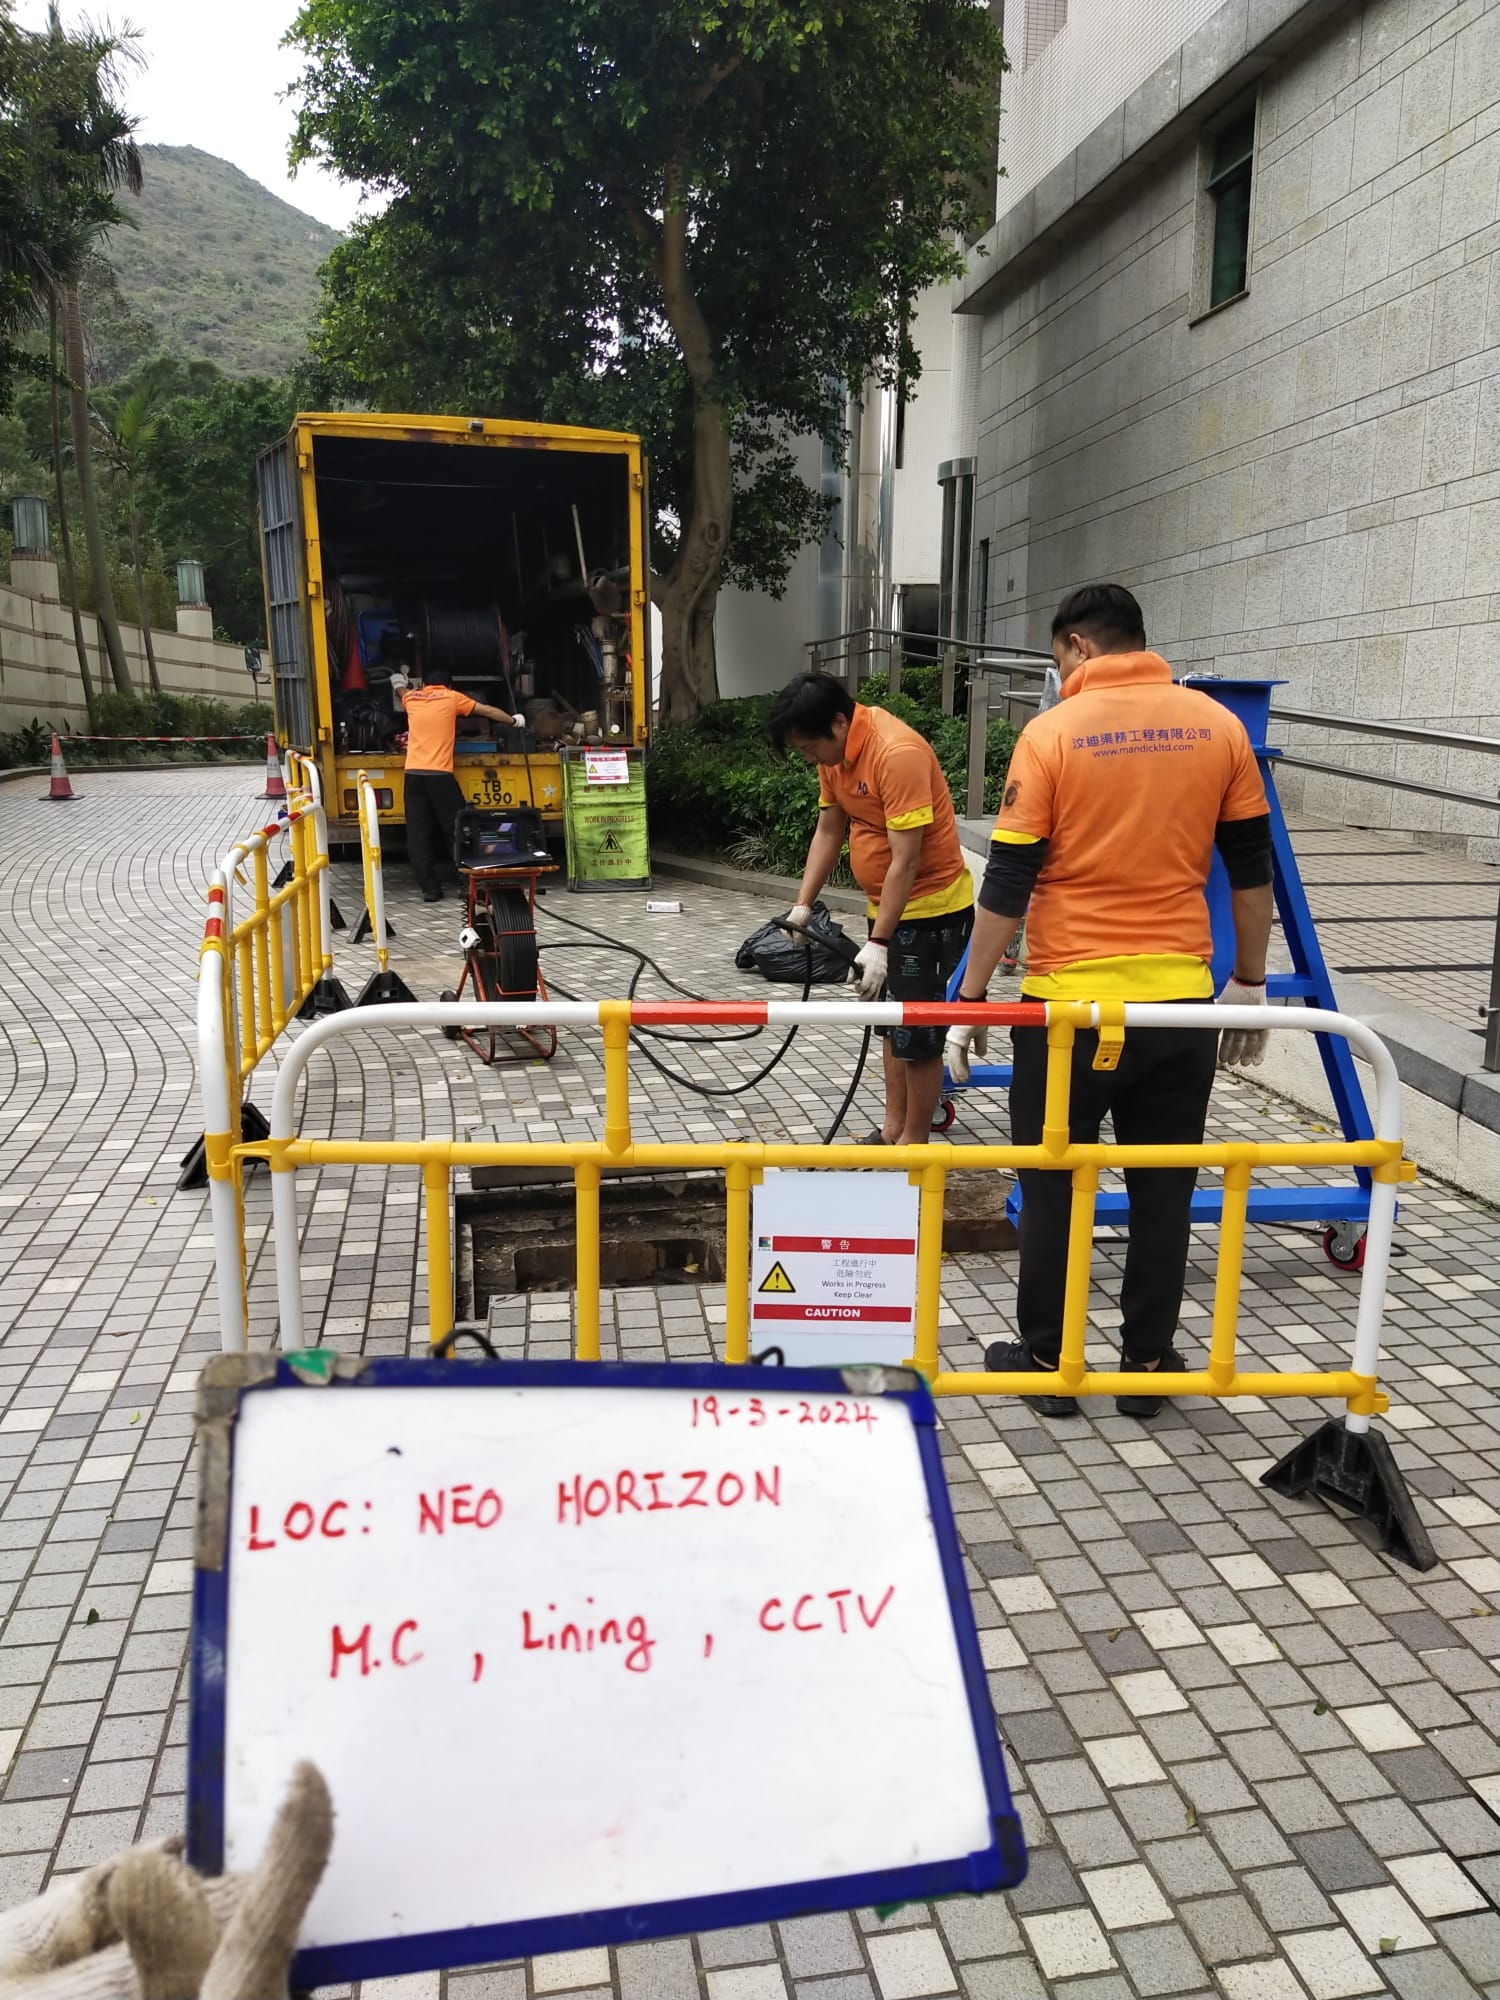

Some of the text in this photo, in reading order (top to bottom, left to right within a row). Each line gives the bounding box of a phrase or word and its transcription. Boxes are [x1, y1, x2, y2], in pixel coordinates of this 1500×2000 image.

[1072, 727, 1211, 750] 汶迪渠務工程有限公司
[1092, 743, 1194, 758] www.mandickltd.com
[481, 780, 502, 793] TB
[472, 792, 513, 805] 5390
[821, 1280, 886, 1289] Works in Progress
[834, 1291, 873, 1299] Keep Clear
[804, 1308, 861, 1318] CAUTION
[691, 1395, 879, 1432] 19-3-2024
[247, 1464, 782, 1554] LOC: NEO HORIZON
[521, 1596, 658, 1675] Lining
[758, 1584, 897, 1635] CCTV
